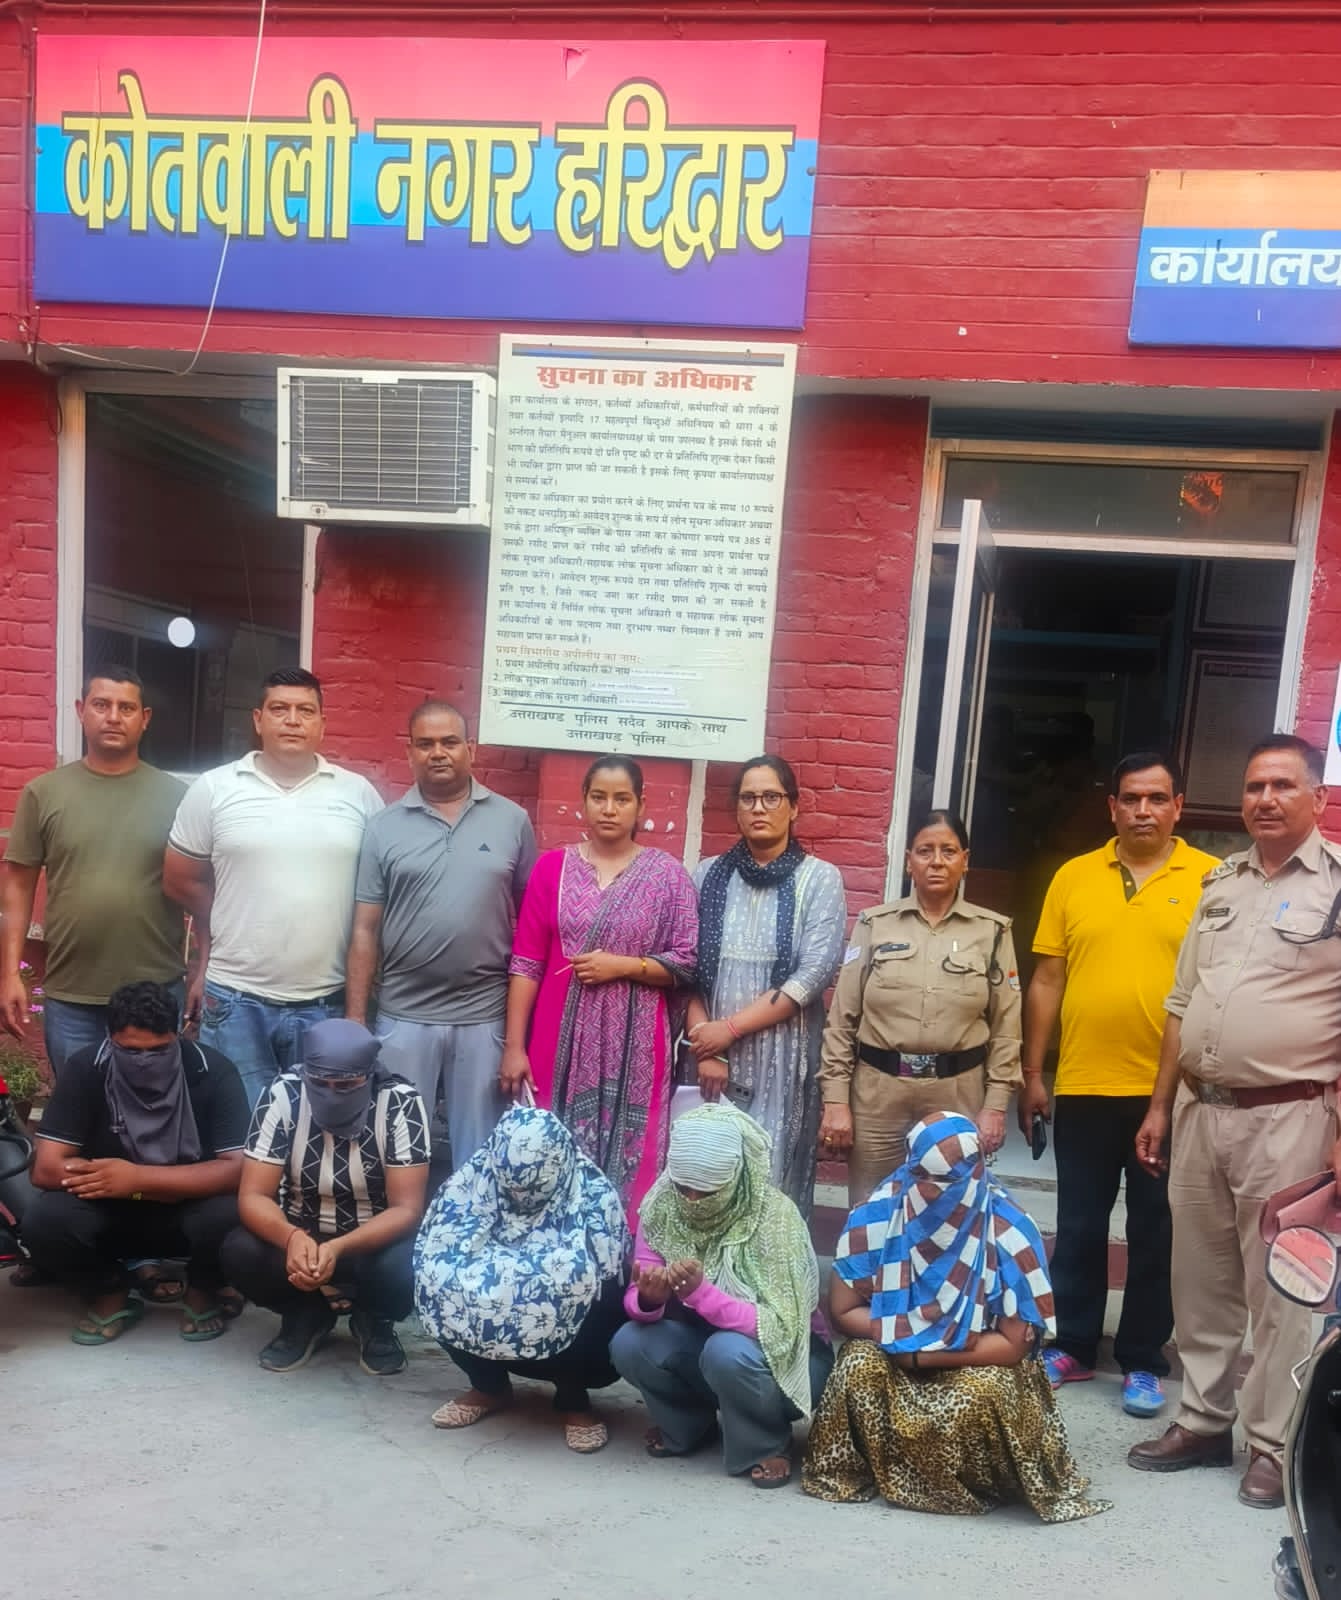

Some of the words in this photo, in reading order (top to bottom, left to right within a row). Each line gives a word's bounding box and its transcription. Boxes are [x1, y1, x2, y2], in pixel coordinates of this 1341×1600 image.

[62, 69, 358, 242] कोतवाली
[374, 118, 542, 247] नगर
[554, 76, 796, 270] हरिद्वार
[1150, 230, 1341, 286] कार्यालय
[612, 369, 645, 386] का
[653, 366, 755, 391] अधिकार
[744, 536, 760, 545] 385
[510, 708, 565, 722] उत्तराखण्ड
[573, 710, 608, 728] पुलिस
[655, 714, 691, 730] आपके
[700, 720, 727, 733] साथ
[565, 728, 623, 742] उत्तराखण्ड
[630, 729, 666, 748] पुलिस
